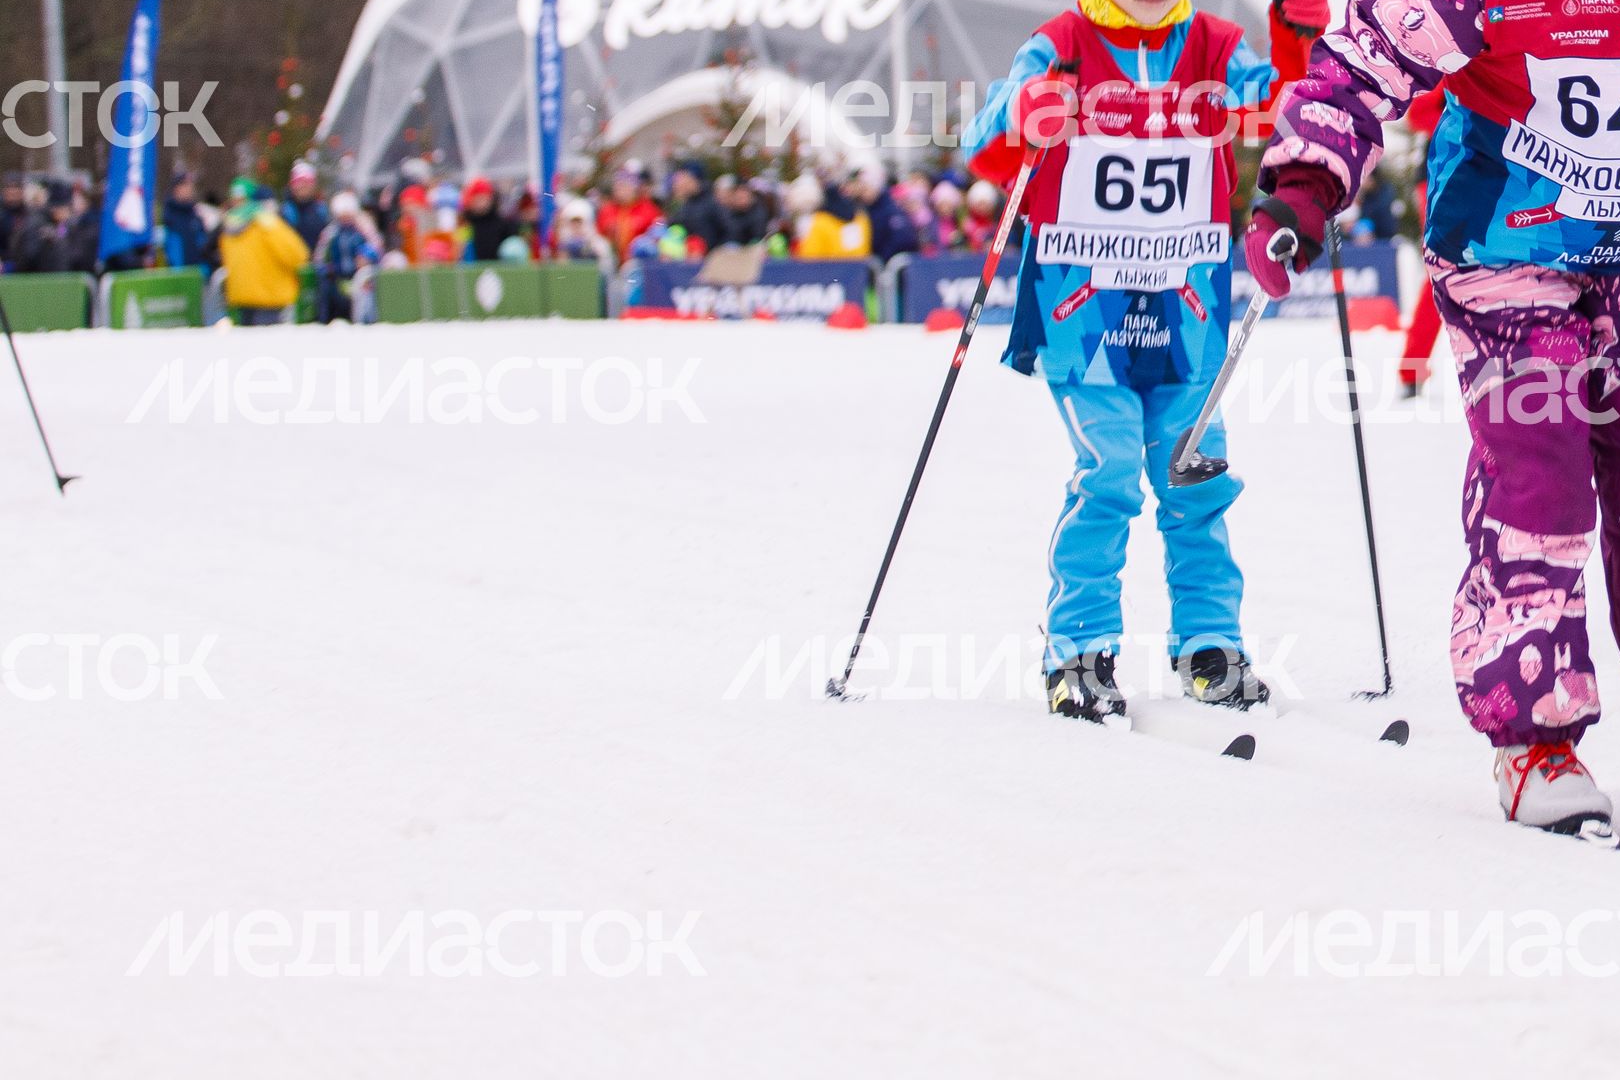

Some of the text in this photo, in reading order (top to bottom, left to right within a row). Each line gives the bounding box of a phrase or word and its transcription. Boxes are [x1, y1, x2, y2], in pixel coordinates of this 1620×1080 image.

[1550, 29, 1609, 40] УРАЛХИМ
[1043, 230, 1222, 262] МАНЖОСОВСАЯ
[1113, 268, 1168, 288] ЛЫЖНЯ
[1123, 314, 1159, 330] ПАРК
[1100, 325, 1171, 349] ЛАЗУТИНОЙ
